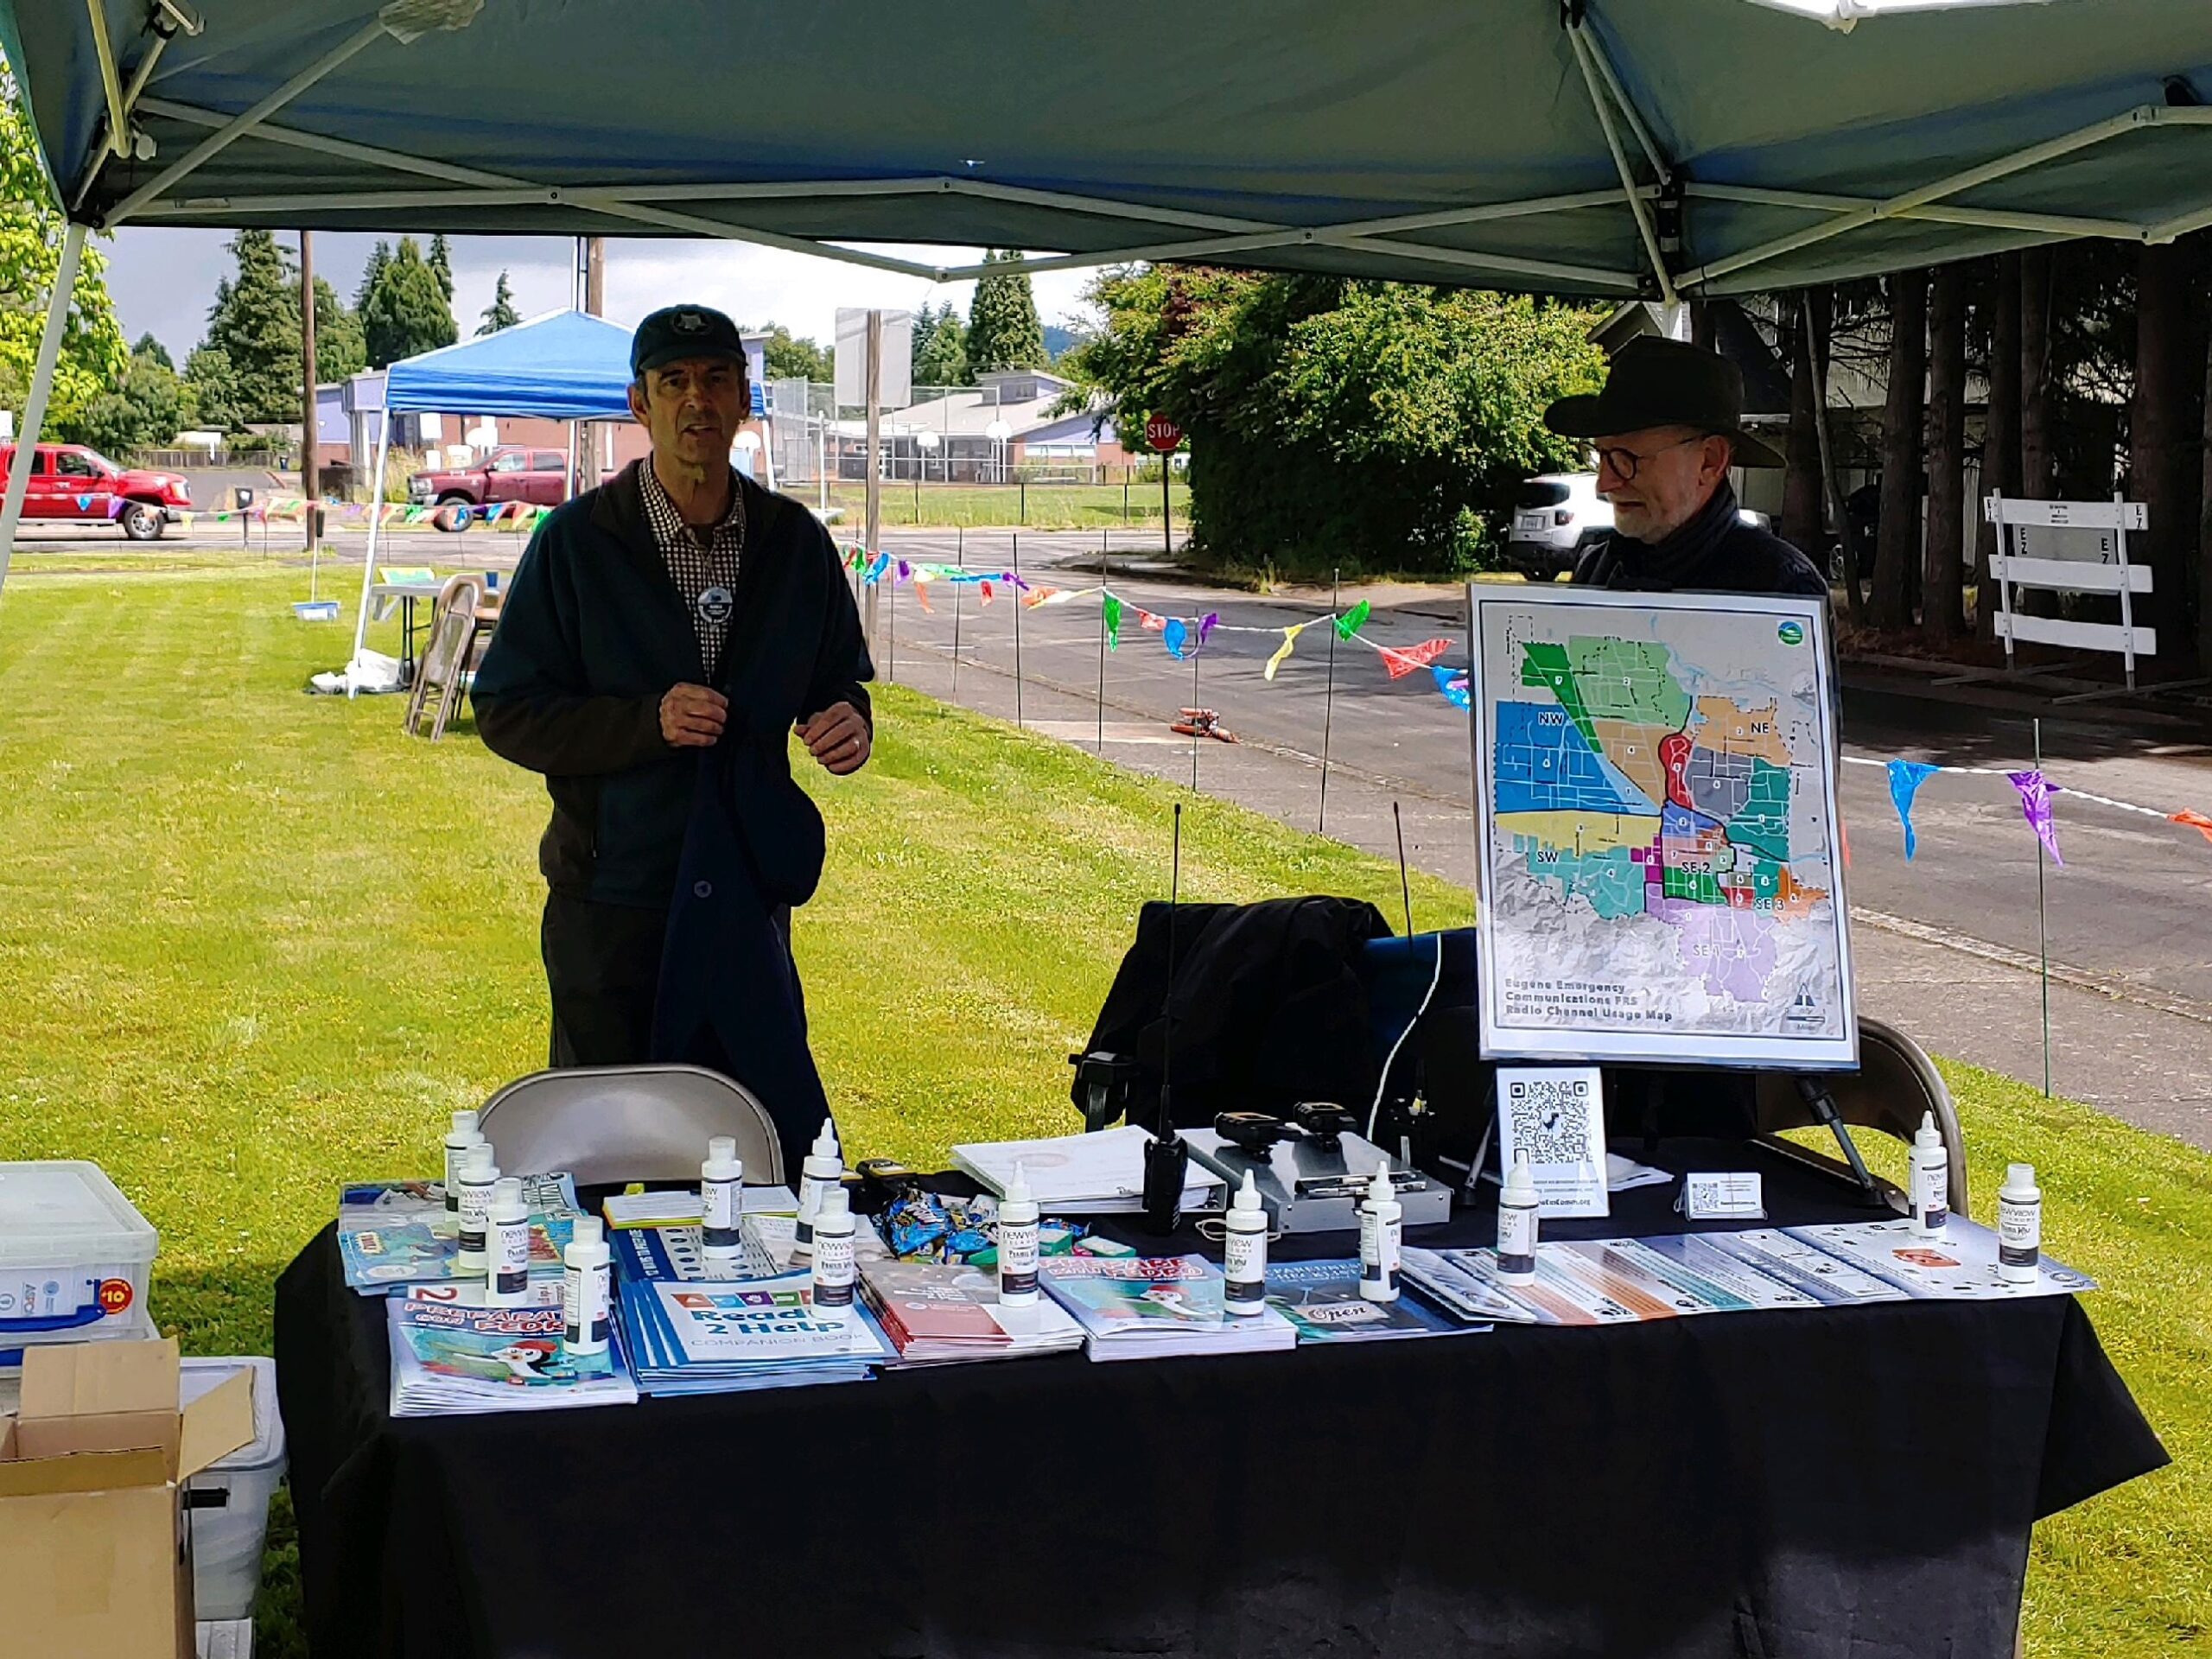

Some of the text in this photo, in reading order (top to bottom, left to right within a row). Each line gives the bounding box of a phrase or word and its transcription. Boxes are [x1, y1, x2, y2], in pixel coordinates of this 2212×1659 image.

[1147, 423, 1180, 439] STOP
[1538, 712, 1564, 727] NW
[1751, 722, 1770, 734] NE
[1537, 851, 1558, 863] SW
[1681, 861, 1710, 874] SE 2
[1755, 898, 1784, 911] SE 3
[1693, 944, 1709, 957] SE
[1505, 978, 1625, 994] Eugene Emergency
[1505, 992, 1638, 1006] Communications FRS
[1505, 1005, 1673, 1022] Radio Channel Usage Map
[690, 1308, 812, 1321] Read
[1308, 1306, 1368, 1321] Open
[476, 1319, 564, 1333] PEDR
[705, 1321, 845, 1334] 2 Help
[691, 1333, 865, 1347] COMPANION BOOK
